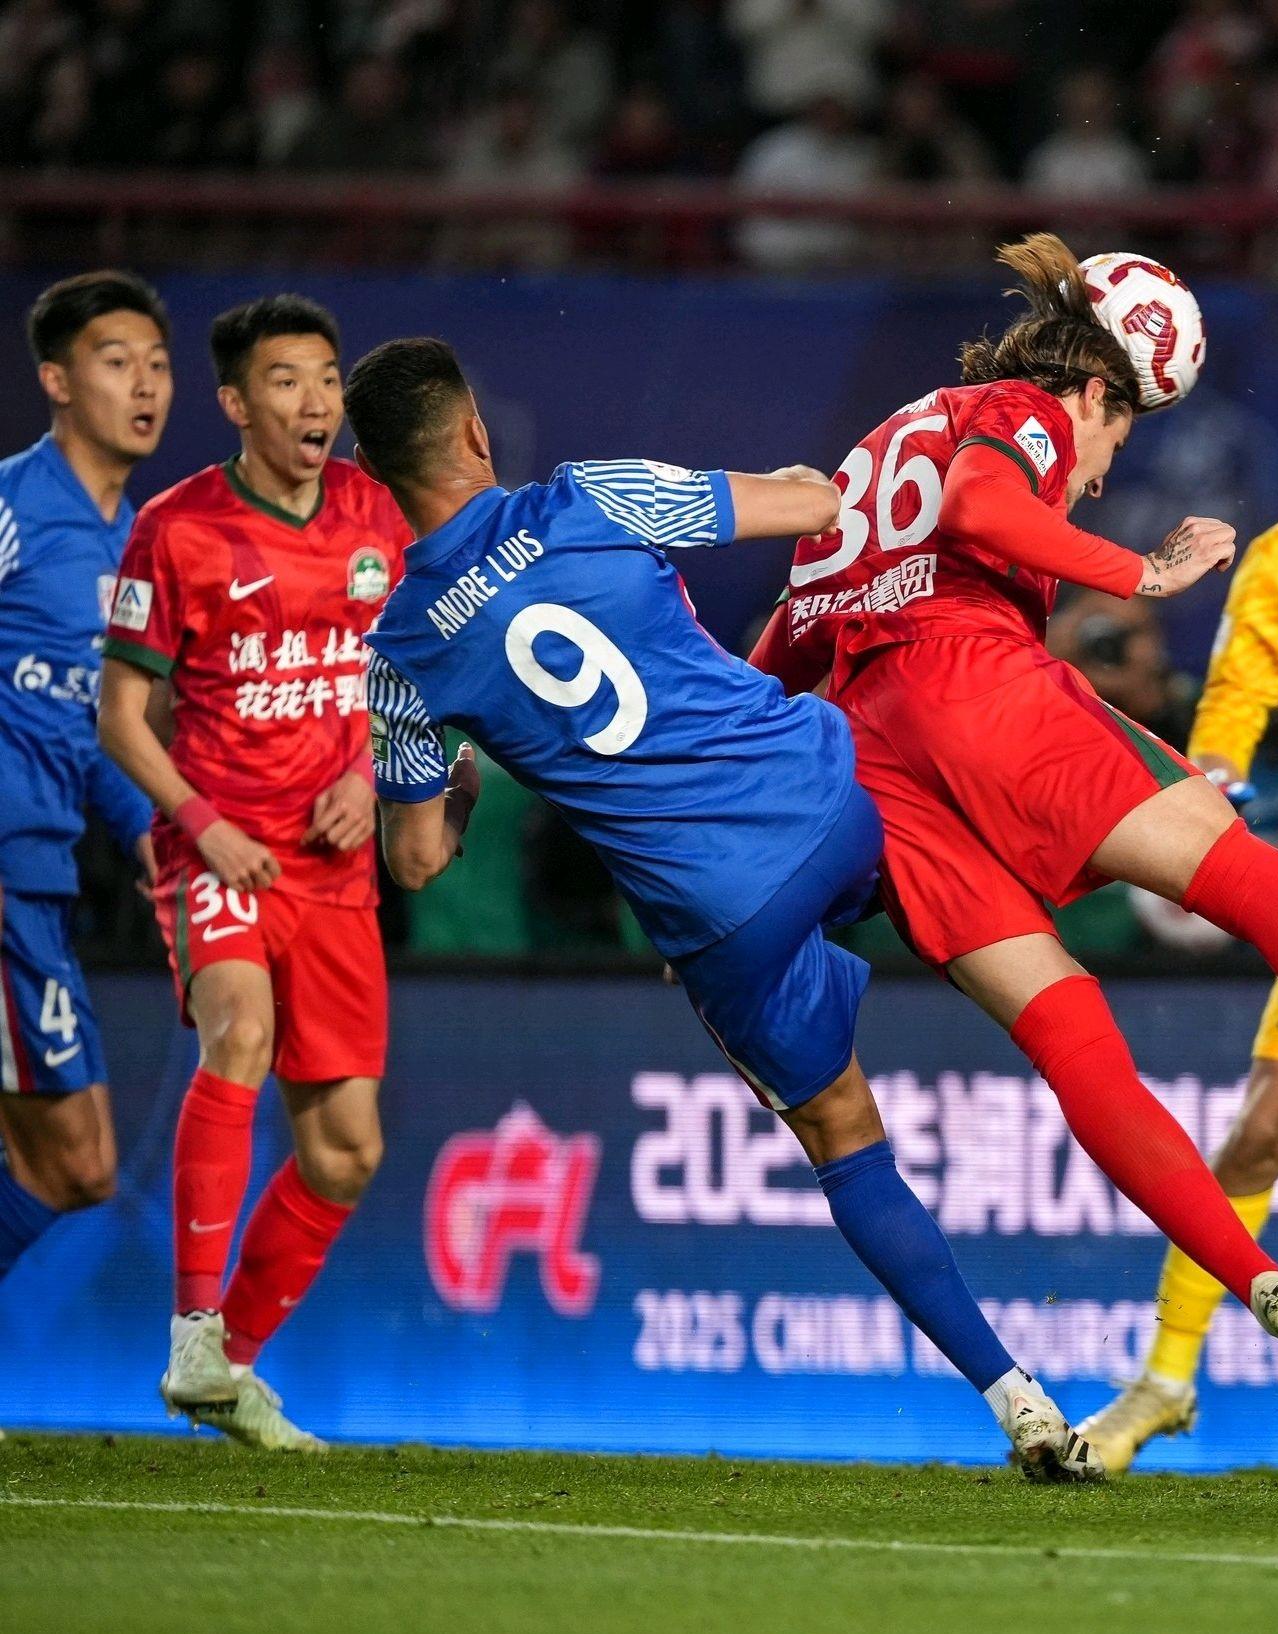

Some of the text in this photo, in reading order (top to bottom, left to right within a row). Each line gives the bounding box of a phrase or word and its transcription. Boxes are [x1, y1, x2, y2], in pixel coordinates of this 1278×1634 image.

[789, 414, 948, 588] 36
[426, 528, 544, 640] ANDRE LUIS
[228, 626, 369, 675] 酒祖杜
[505, 603, 648, 756] 9
[190, 872, 259, 925] 30
[39, 978, 78, 1042] 4
